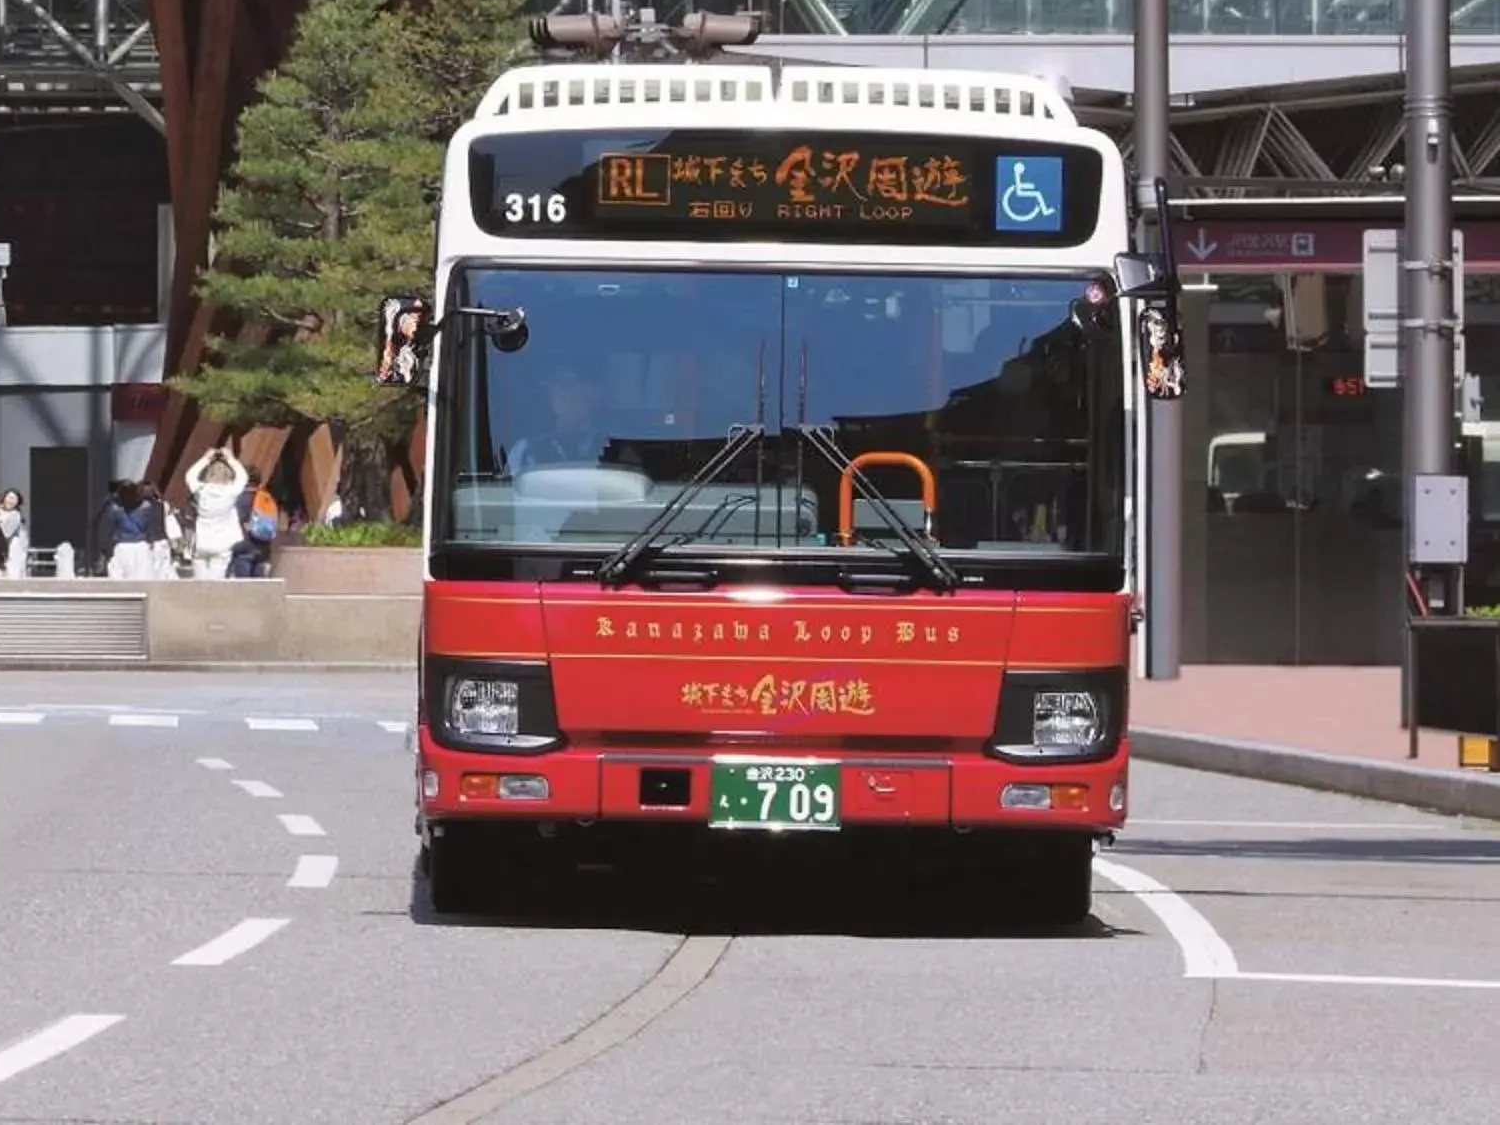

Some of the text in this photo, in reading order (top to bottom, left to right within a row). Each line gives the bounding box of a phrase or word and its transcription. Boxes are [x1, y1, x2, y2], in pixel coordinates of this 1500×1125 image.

[609, 158, 660, 197] RL
[505, 193, 567, 223] 316
[777, 203, 914, 221] RIGHT LOOP
[596, 616, 960, 645] Kanazawa Loop Bus
